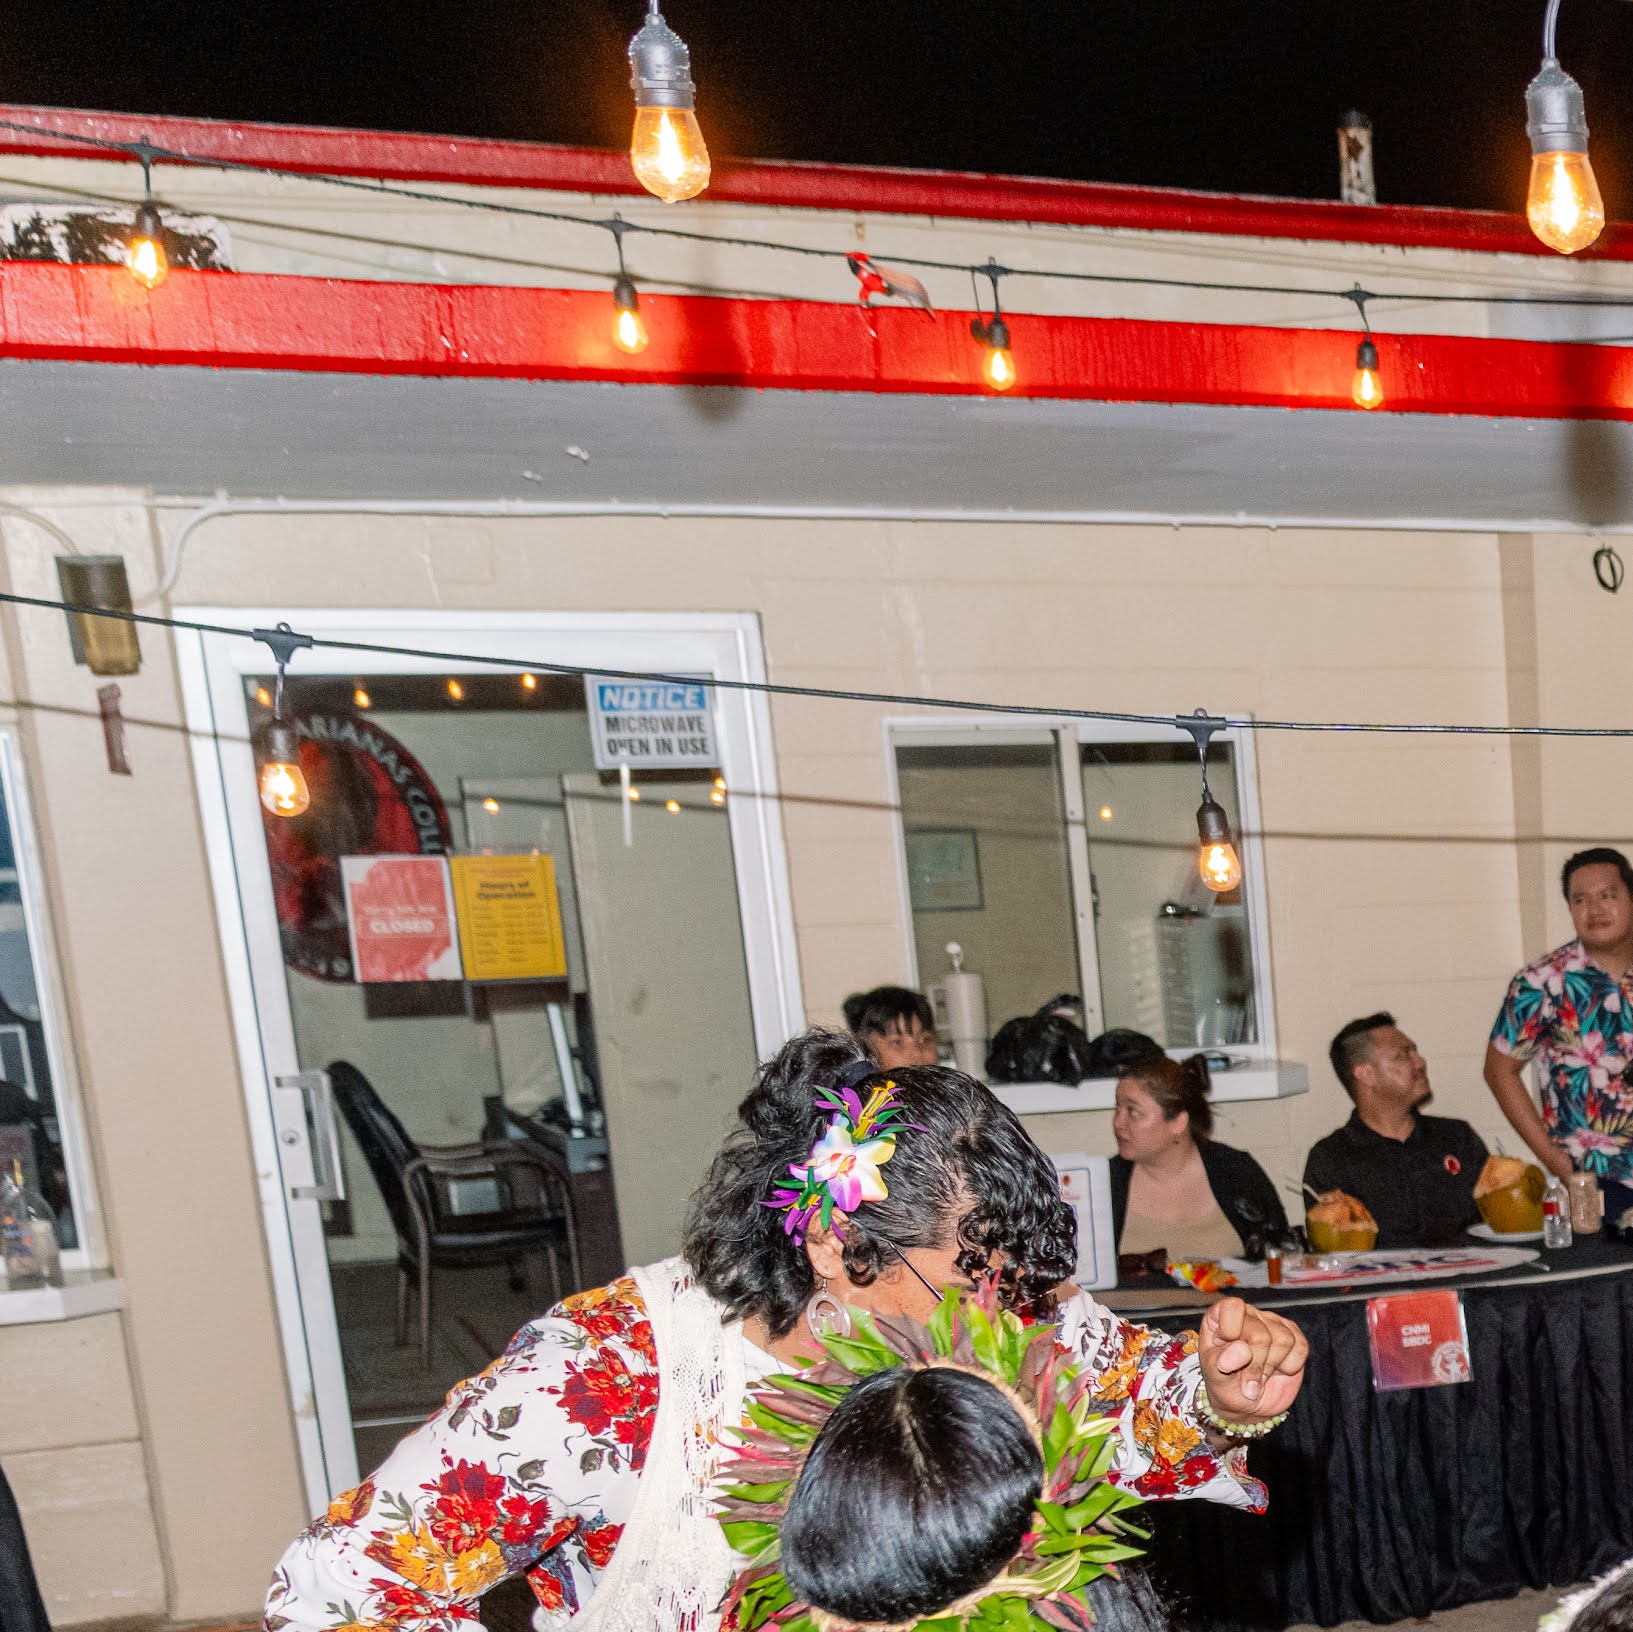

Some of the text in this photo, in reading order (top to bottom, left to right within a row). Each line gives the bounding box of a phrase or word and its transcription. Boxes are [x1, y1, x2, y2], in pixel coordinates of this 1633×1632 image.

[603, 686, 700, 708] NOTICE
[605, 716, 706, 734] MICROWAVE
[655, 738, 673, 755] IN
[678, 737, 710, 755] USE
